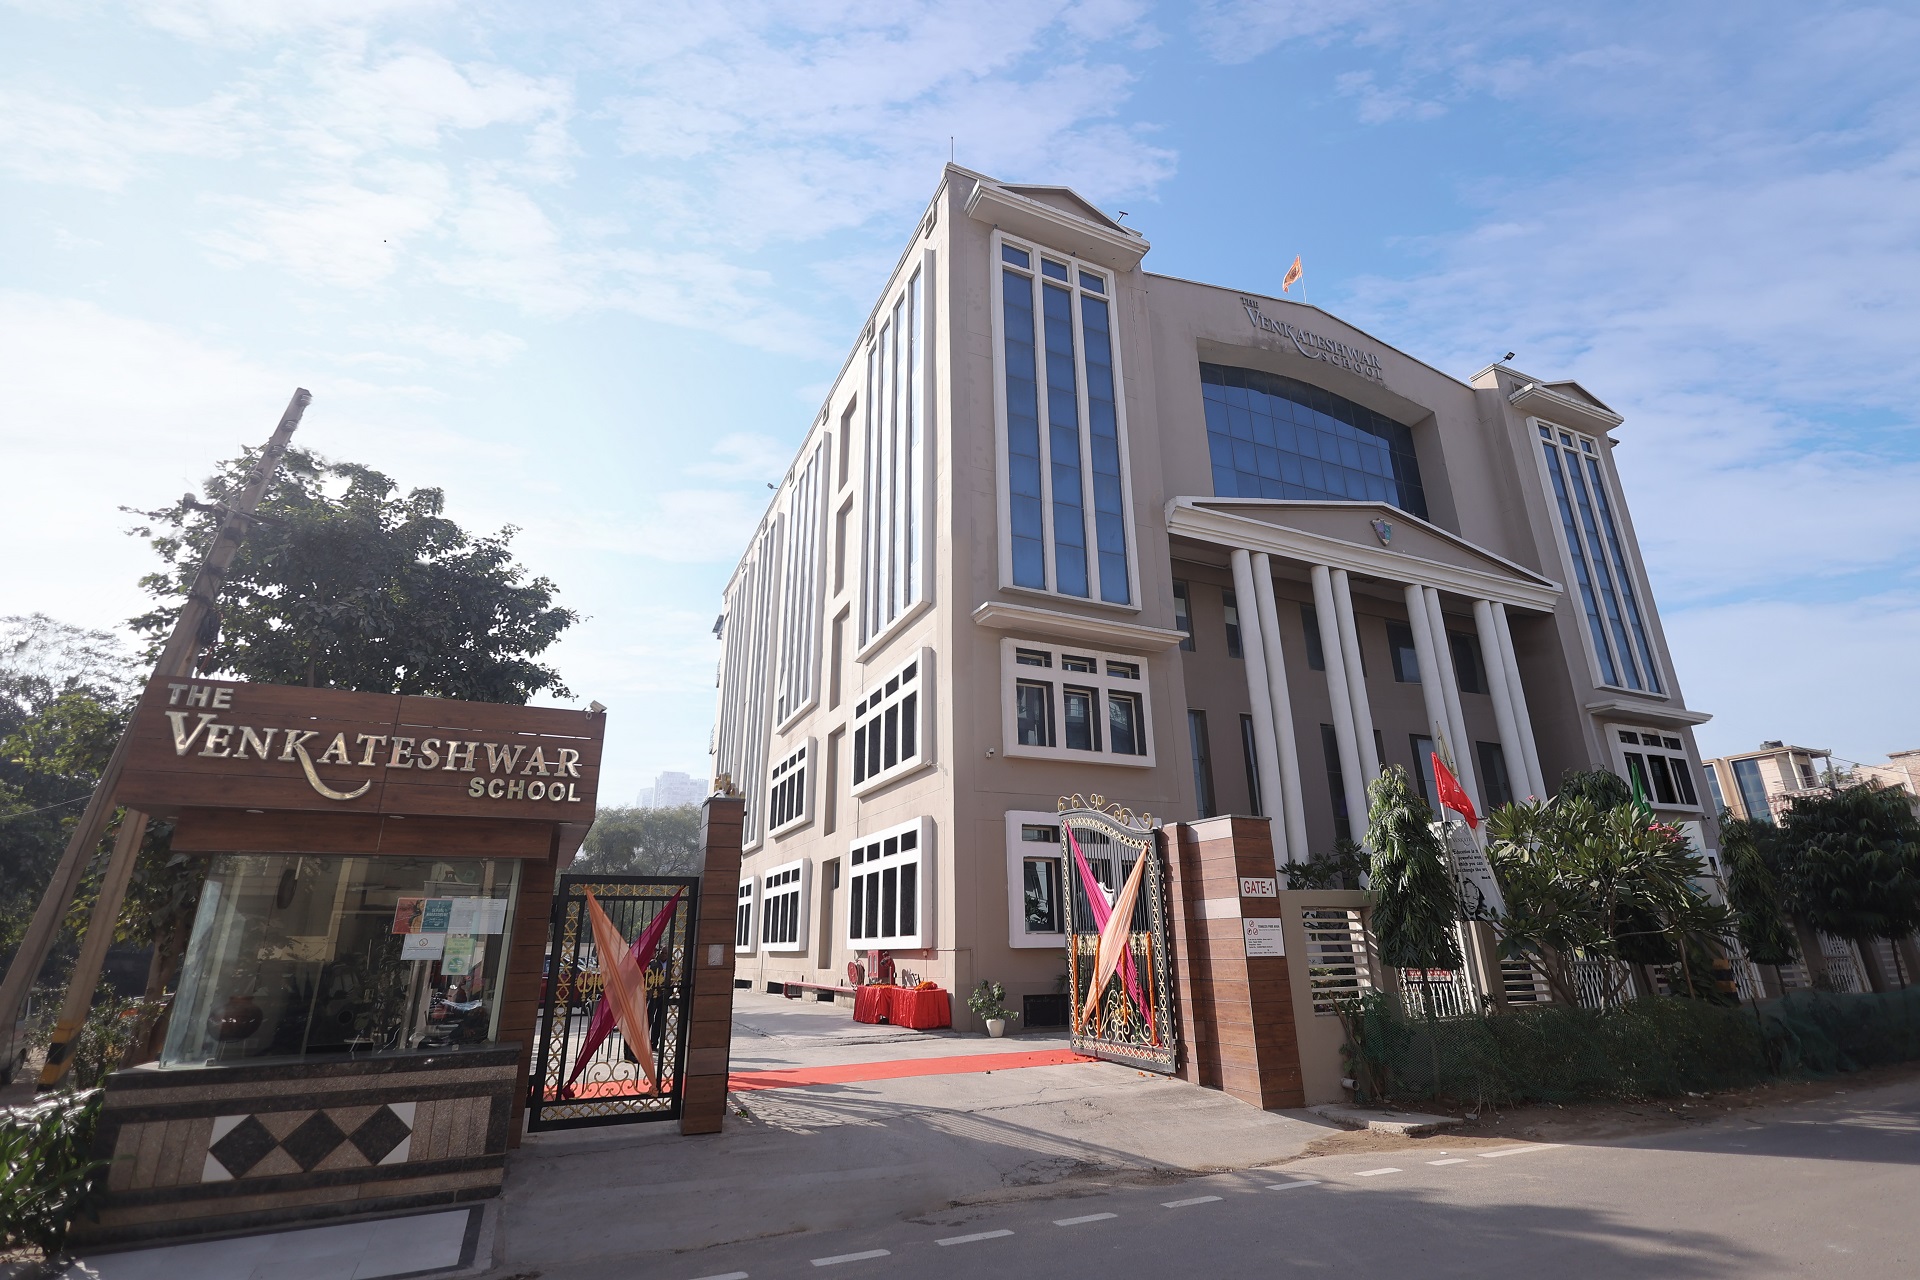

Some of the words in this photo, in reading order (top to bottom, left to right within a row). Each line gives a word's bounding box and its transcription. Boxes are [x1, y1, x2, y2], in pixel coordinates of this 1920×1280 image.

[1240, 297, 1259, 309] THE
[1243, 306, 1382, 370] VENKATESHWAR
[1321, 351, 1383, 380] SCHOOL
[168, 683, 234, 709] THE
[164, 710, 582, 800] VENKATESHWAR
[468, 777, 581, 802] SCHOOL
[1244, 881, 1273, 894] GATE-1
